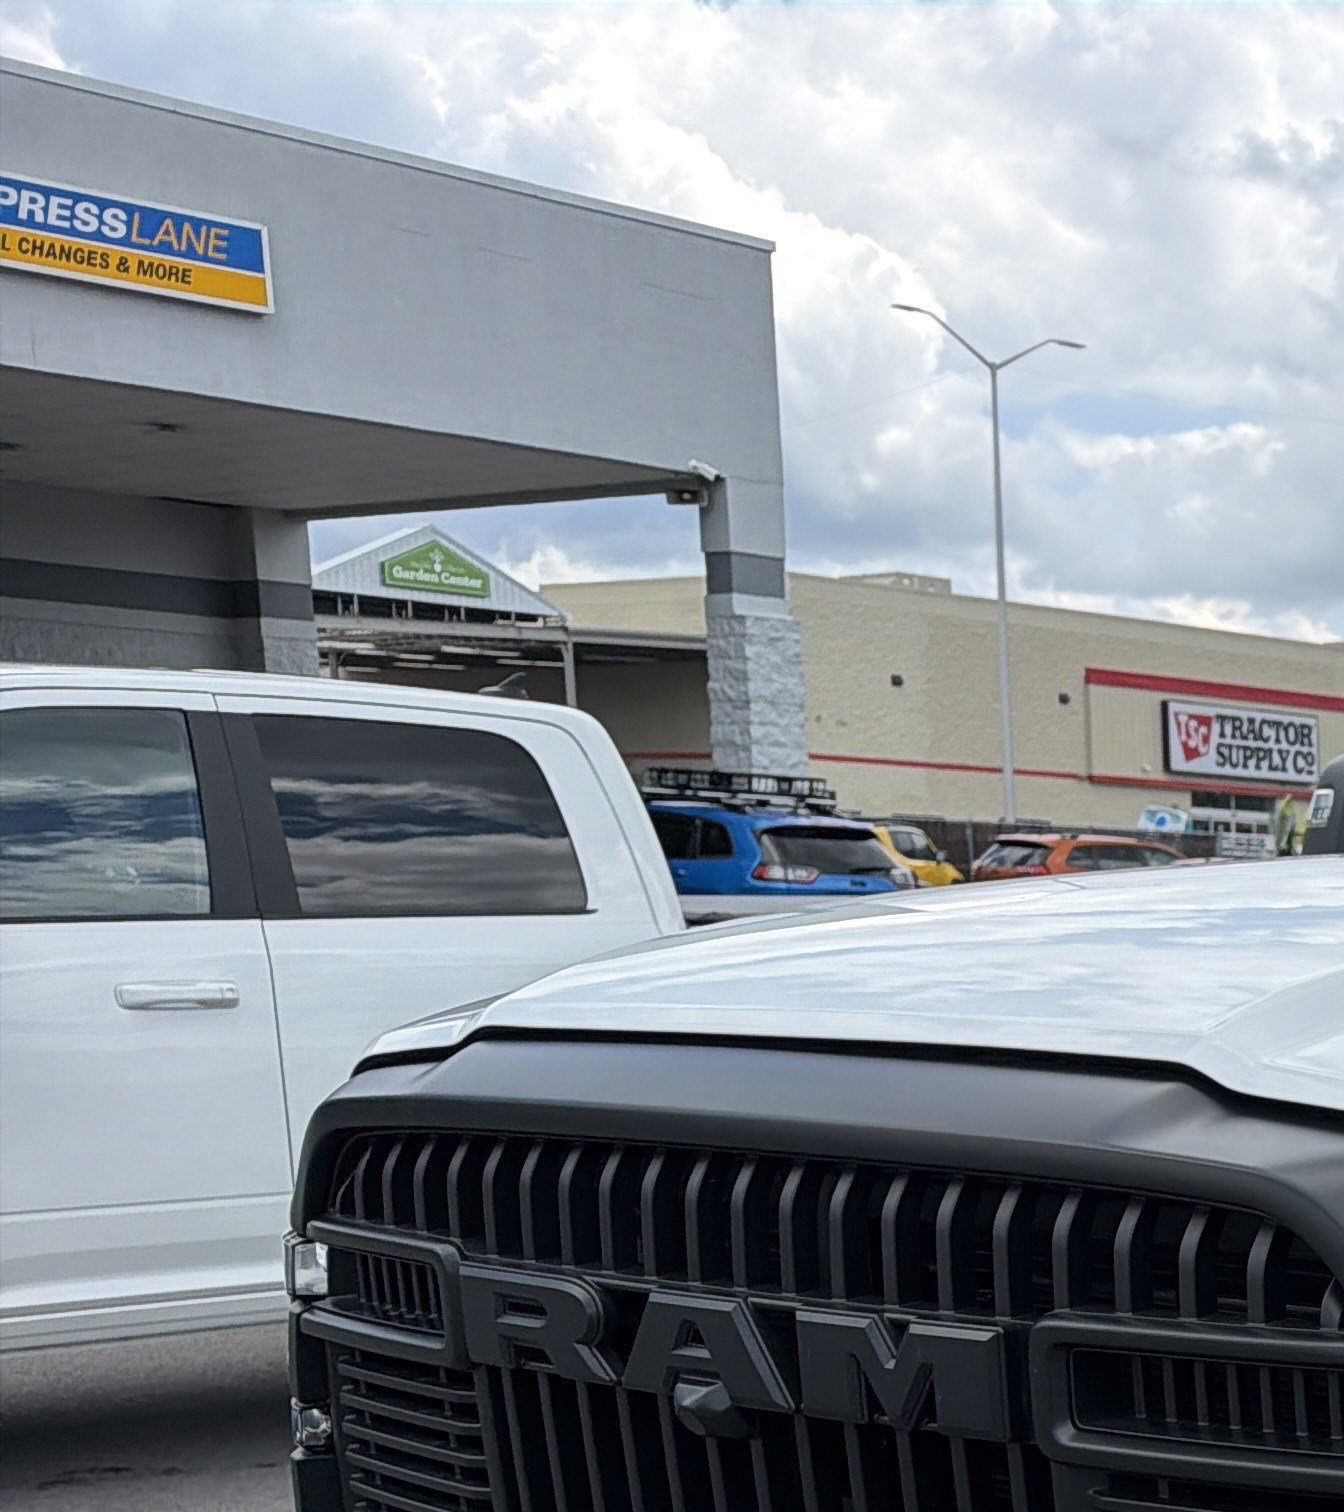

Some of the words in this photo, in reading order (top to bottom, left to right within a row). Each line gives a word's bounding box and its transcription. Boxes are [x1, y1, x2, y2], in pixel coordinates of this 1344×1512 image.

[17, 235, 110, 270] CHANGES
[115, 255, 130, 275] &
[136, 258, 193, 286] MORE
[1215, 713, 1314, 749] TRACTOR
[1215, 742, 1290, 774] SUPPLY
[458, 1260, 1008, 1443] RAM
